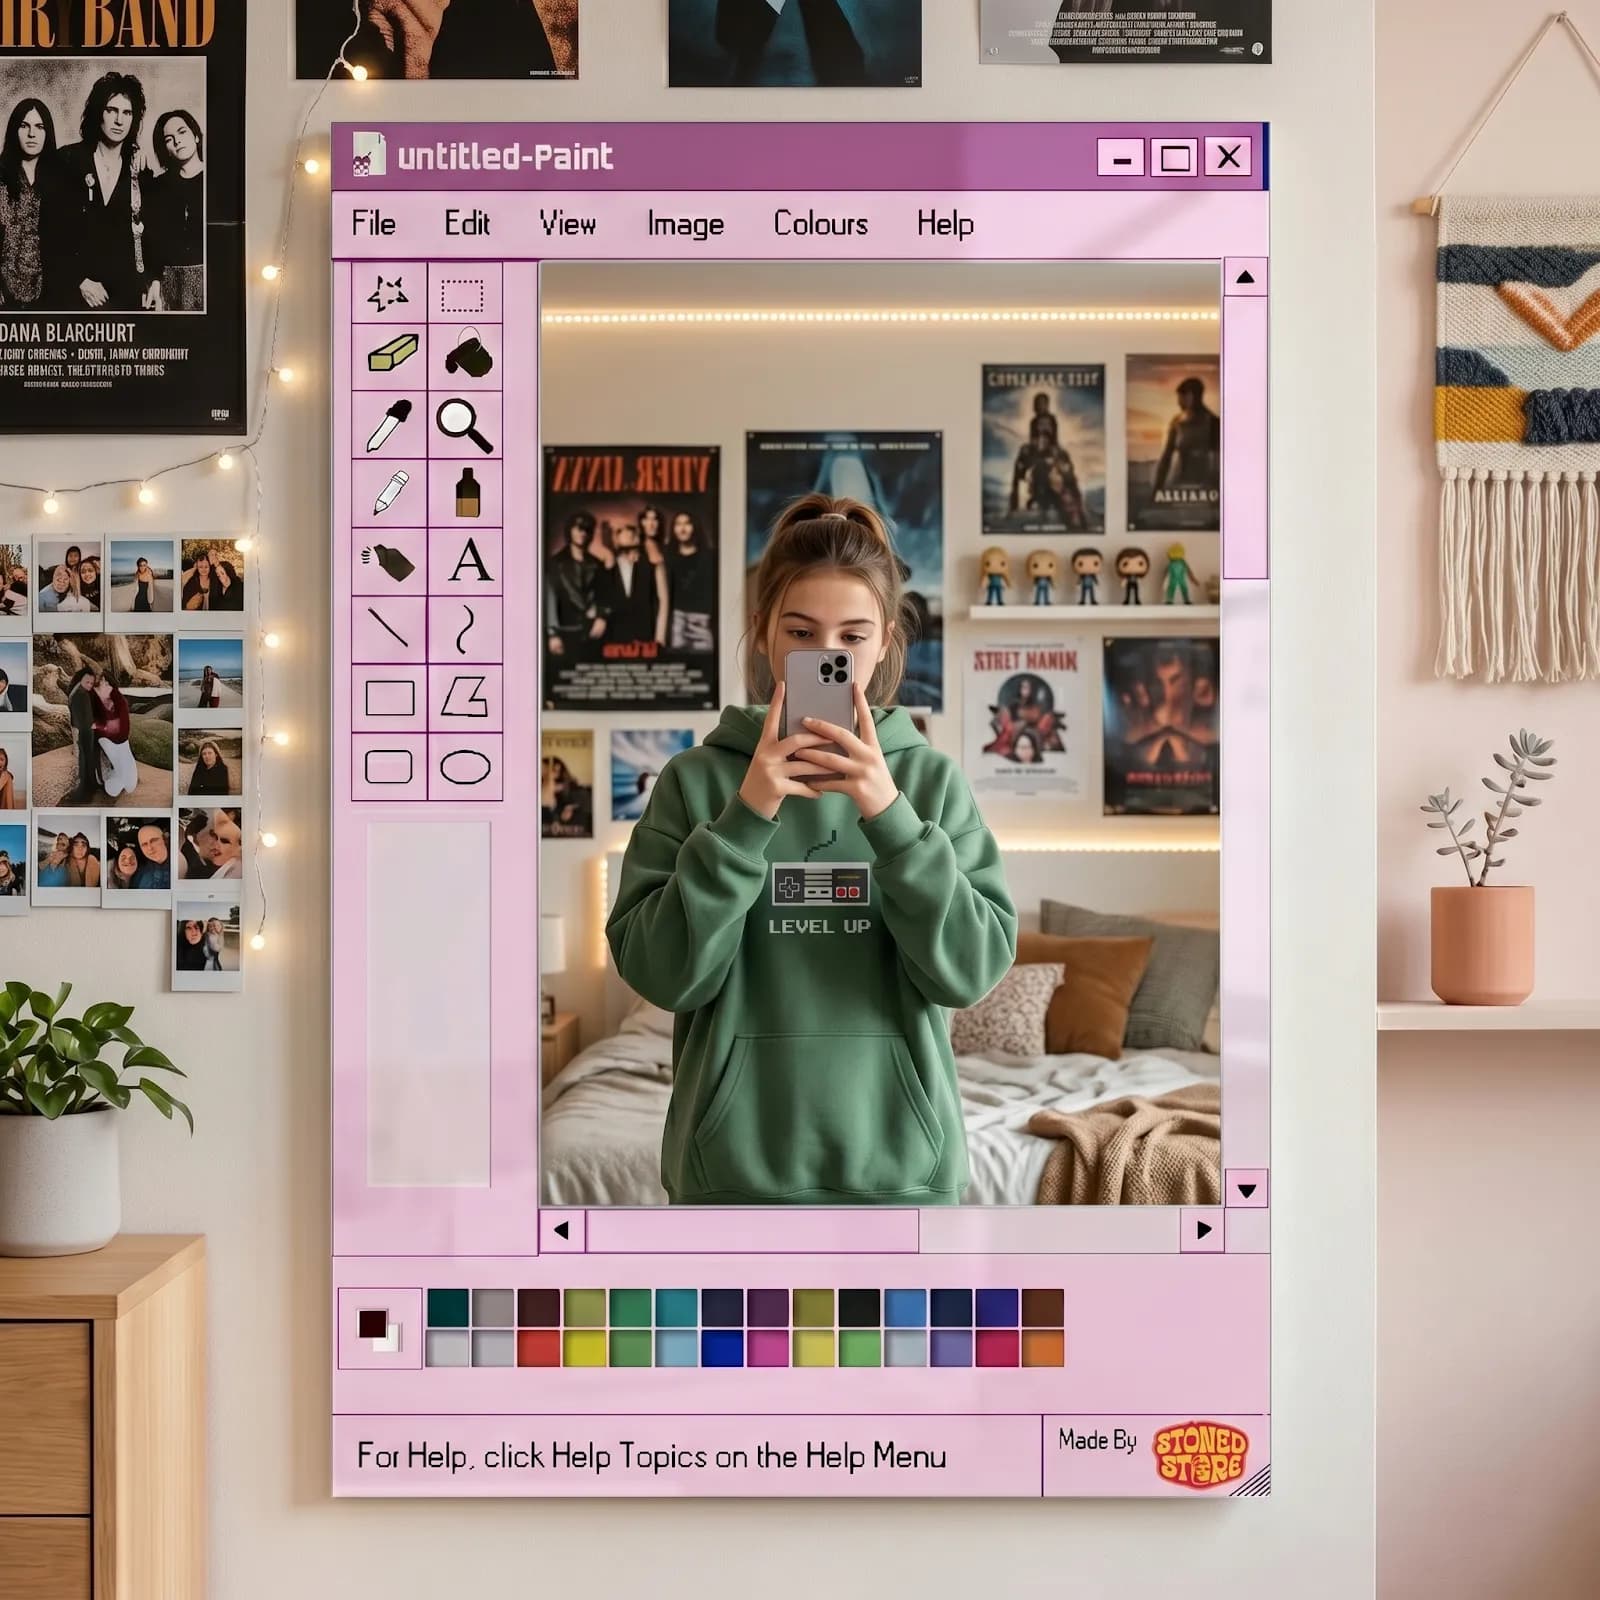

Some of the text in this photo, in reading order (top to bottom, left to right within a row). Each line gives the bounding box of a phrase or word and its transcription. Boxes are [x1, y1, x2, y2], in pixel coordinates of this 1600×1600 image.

[81, 0, 215, 47] BAND
[398, 142, 614, 170] untitled-Paint
[353, 209, 396, 235] File
[445, 209, 491, 235] Edit
[540, 209, 596, 235] View
[649, 209, 724, 241] Image
[774, 209, 868, 236] Colours
[918, 209, 974, 242] Help
[46, 323, 136, 342] BLARCHURT
[769, 920, 872, 934] LEVEL UP
[1059, 1428, 1137, 1455] Made By
[358, 1441, 399, 1468] For
[485, 1441, 545, 1468] click
[553, 1441, 611, 1474] Help
[619, 1441, 707, 1474] Topics
[716, 1450, 747, 1468] on
[757, 1441, 797, 1468] the
[807, 1441, 865, 1474] Help
[874, 1441, 946, 1468] Menu
[1156, 1426, 1247, 1485] STONED STORE
